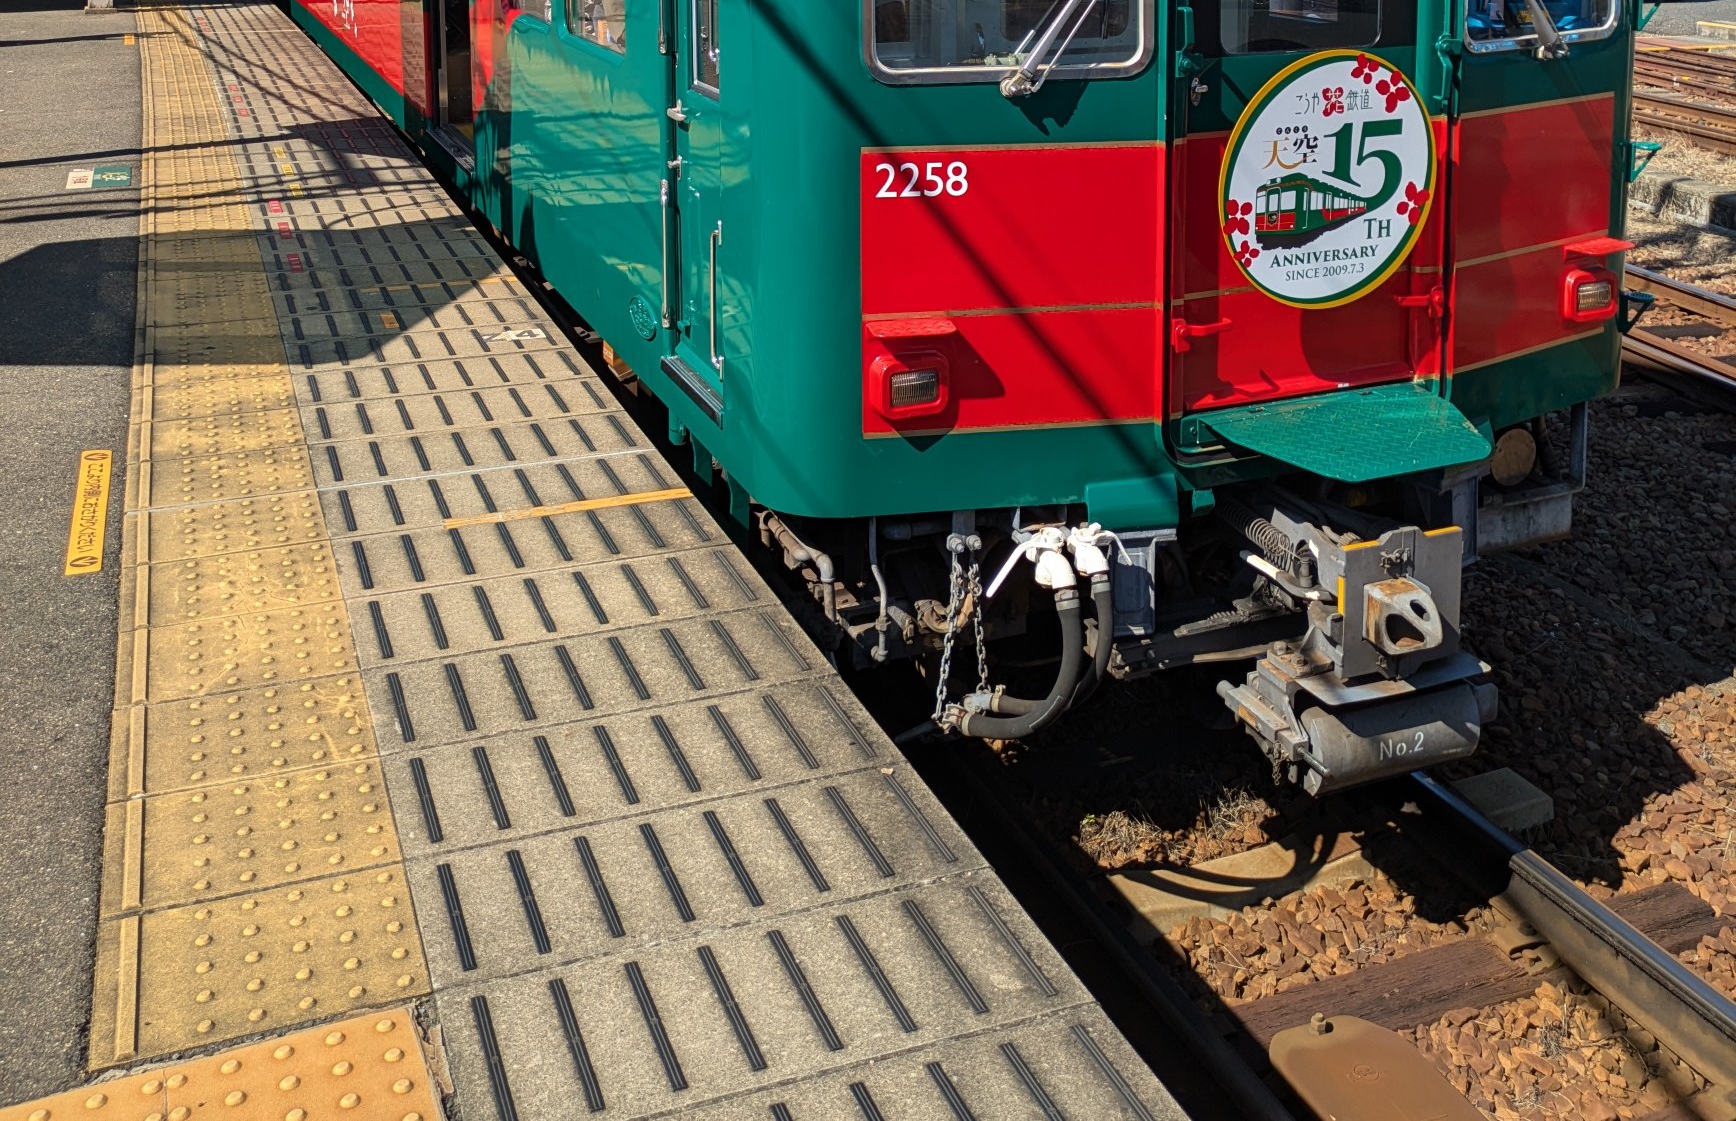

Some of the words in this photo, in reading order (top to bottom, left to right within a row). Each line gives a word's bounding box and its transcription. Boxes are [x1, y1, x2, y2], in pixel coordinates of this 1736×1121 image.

[1295, 86, 1373, 116] こうや花鉄道
[1262, 134, 1320, 169] 天空
[1322, 118, 1403, 205] 15
[875, 161, 968, 198] 2258
[1363, 218, 1392, 240] TH
[1269, 244, 1380, 269] ANNIVERSARY
[1285, 267, 1320, 282] SINCE
[1322, 262, 1365, 278] 2009.7.3
[1379, 731, 1424, 760] No.2
